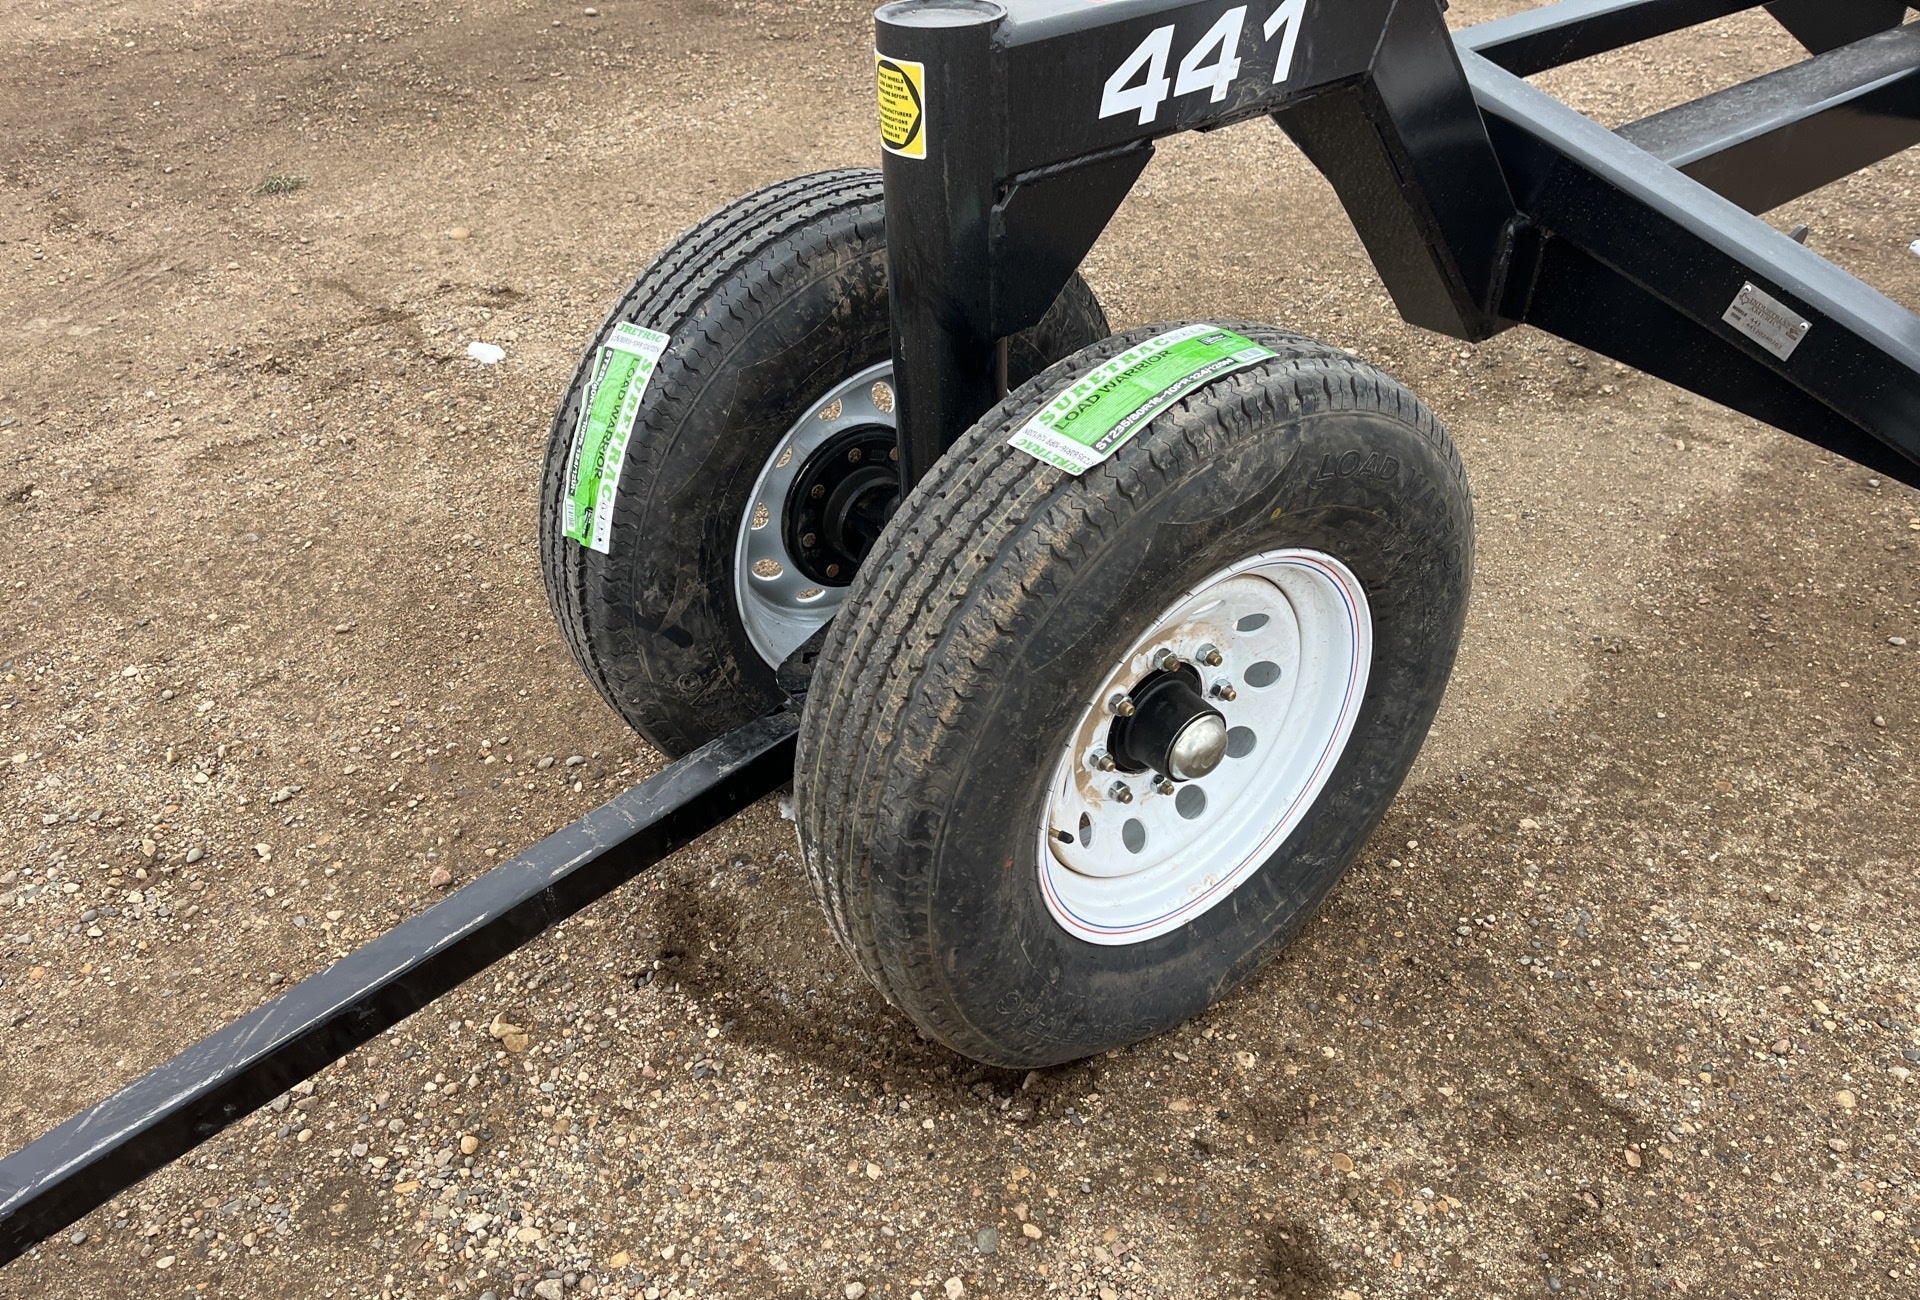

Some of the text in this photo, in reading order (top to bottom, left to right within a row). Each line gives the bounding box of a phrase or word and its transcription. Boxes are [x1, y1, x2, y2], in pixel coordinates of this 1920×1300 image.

[1099, 0, 1307, 125] 441
[618, 357, 640, 401] LOAD
[1038, 337, 1170, 426] SURETRAC
[1054, 349, 1172, 430] LOAD WARRIOR
[594, 403, 621, 480] WARRIOR
[602, 357, 653, 502] SURETRAC
[1015, 438, 1086, 474] SURETRAC
[1315, 448, 1400, 482] LOAD
